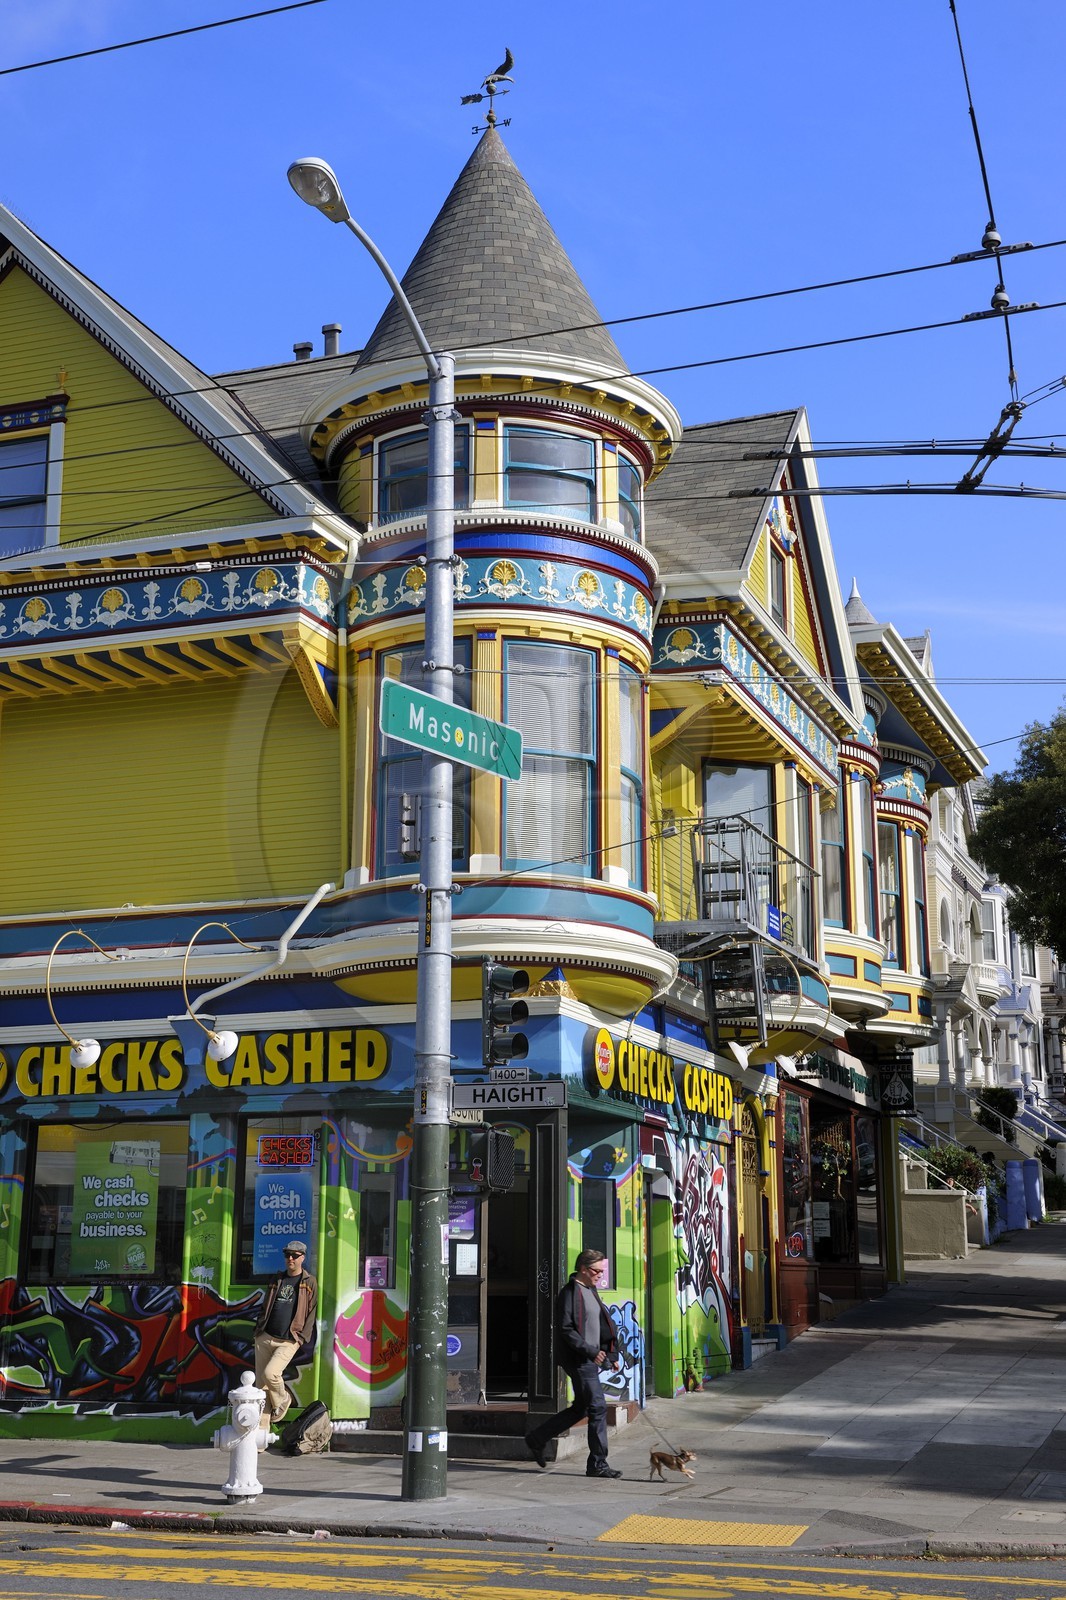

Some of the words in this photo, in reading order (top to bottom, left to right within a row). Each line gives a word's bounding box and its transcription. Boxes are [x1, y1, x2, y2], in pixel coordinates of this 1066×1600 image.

[409, 702, 500, 761] Masonic
[597, 1043, 612, 1059] Money
[16, 1039, 184, 1097] CHECKS
[205, 1029, 388, 1088] CASHED
[597, 1057, 610, 1073] Mart
[494, 1070, 517, 1080] 1400
[618, 1039, 675, 1105] CHECKS
[683, 1063, 733, 1121] CASHED
[473, 1086, 547, 1104] HAIGHT
[882, 1092, 912, 1104] PEOPLE
[263, 1138, 311, 1151] CHECKS
[260, 1152, 311, 1164] CASHED
[83, 1176, 102, 1189] We
[105, 1175, 134, 1189] cash
[268, 1183, 285, 1194] We
[94, 1190, 149, 1207] checks
[260, 1190, 301, 1210] cash
[86, 1211, 115, 1221] payable
[117, 1211, 125, 1219] to
[126, 1211, 143, 1220] your
[274, 1209, 306, 1220] more
[80, 1222, 147, 1238] business.
[261, 1221, 307, 1234] checks!
[127, 1251, 145, 1262] MORE
